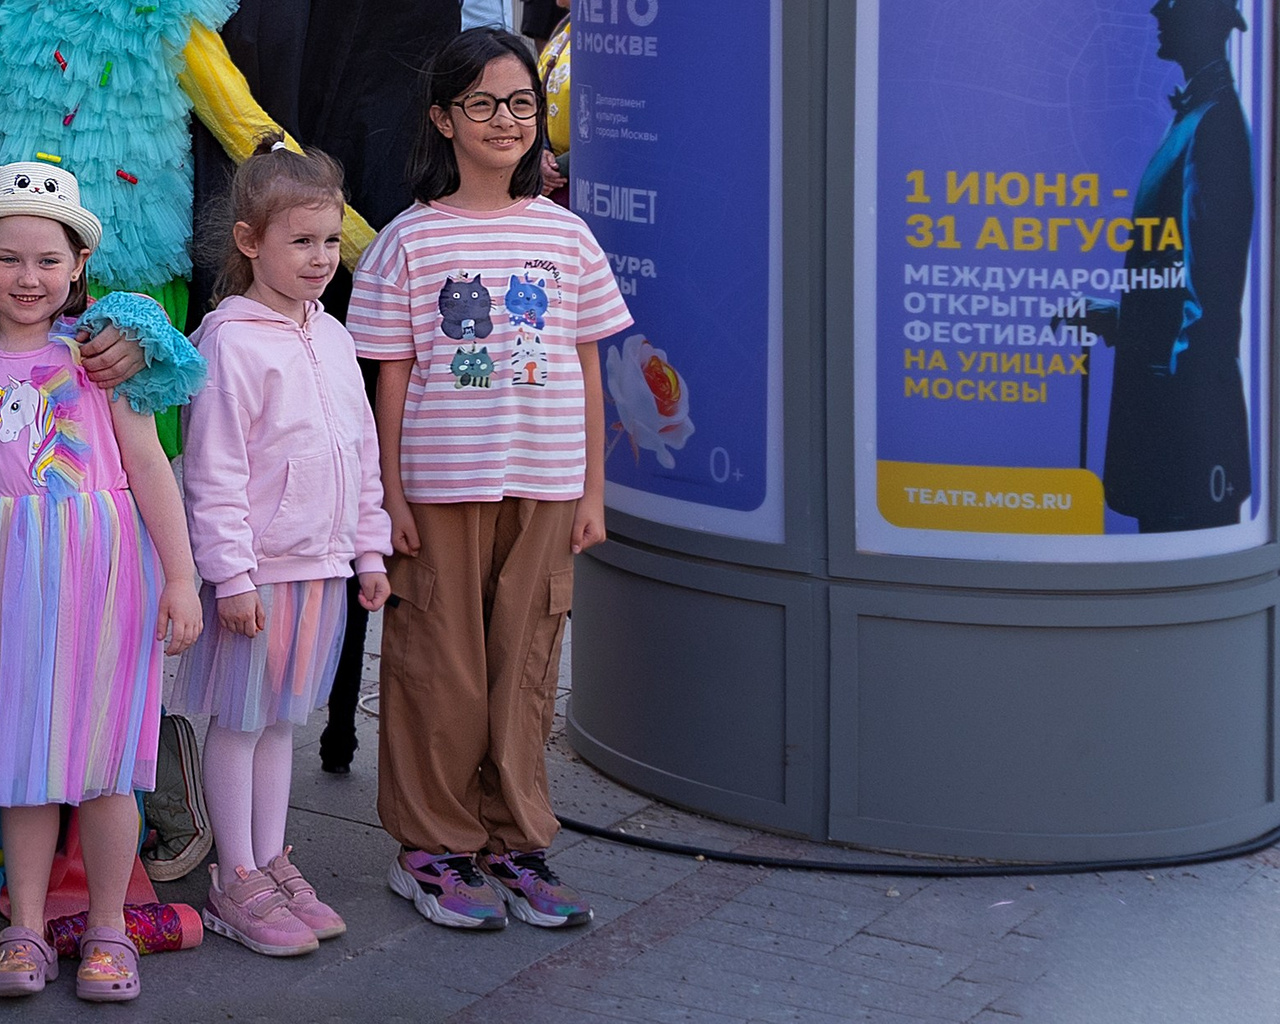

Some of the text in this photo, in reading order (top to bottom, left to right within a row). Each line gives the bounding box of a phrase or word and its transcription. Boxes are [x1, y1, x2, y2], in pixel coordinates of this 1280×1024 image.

[584, 32, 658, 57] МОСКВЕ
[905, 170, 931, 204] 1
[946, 171, 1099, 207] ИЮНЯ
[905, 214, 1184, 252] 31 АВГУСТА
[904, 261, 1187, 294] МЕЖДУНАРОДНЫЙ
[903, 291, 1087, 318] ОТКРЫТЫЙ
[903, 320, 1098, 347] ФЕСТИВАЛЬ
[904, 348, 1088, 377] НА УЛИЦАХ
[904, 377, 1047, 403] МОСКВЫ
[710, 446, 745, 483] 0+
[1209, 464, 1235, 503] 0+
[904, 487, 1072, 510] TEATR.MOS.RU
